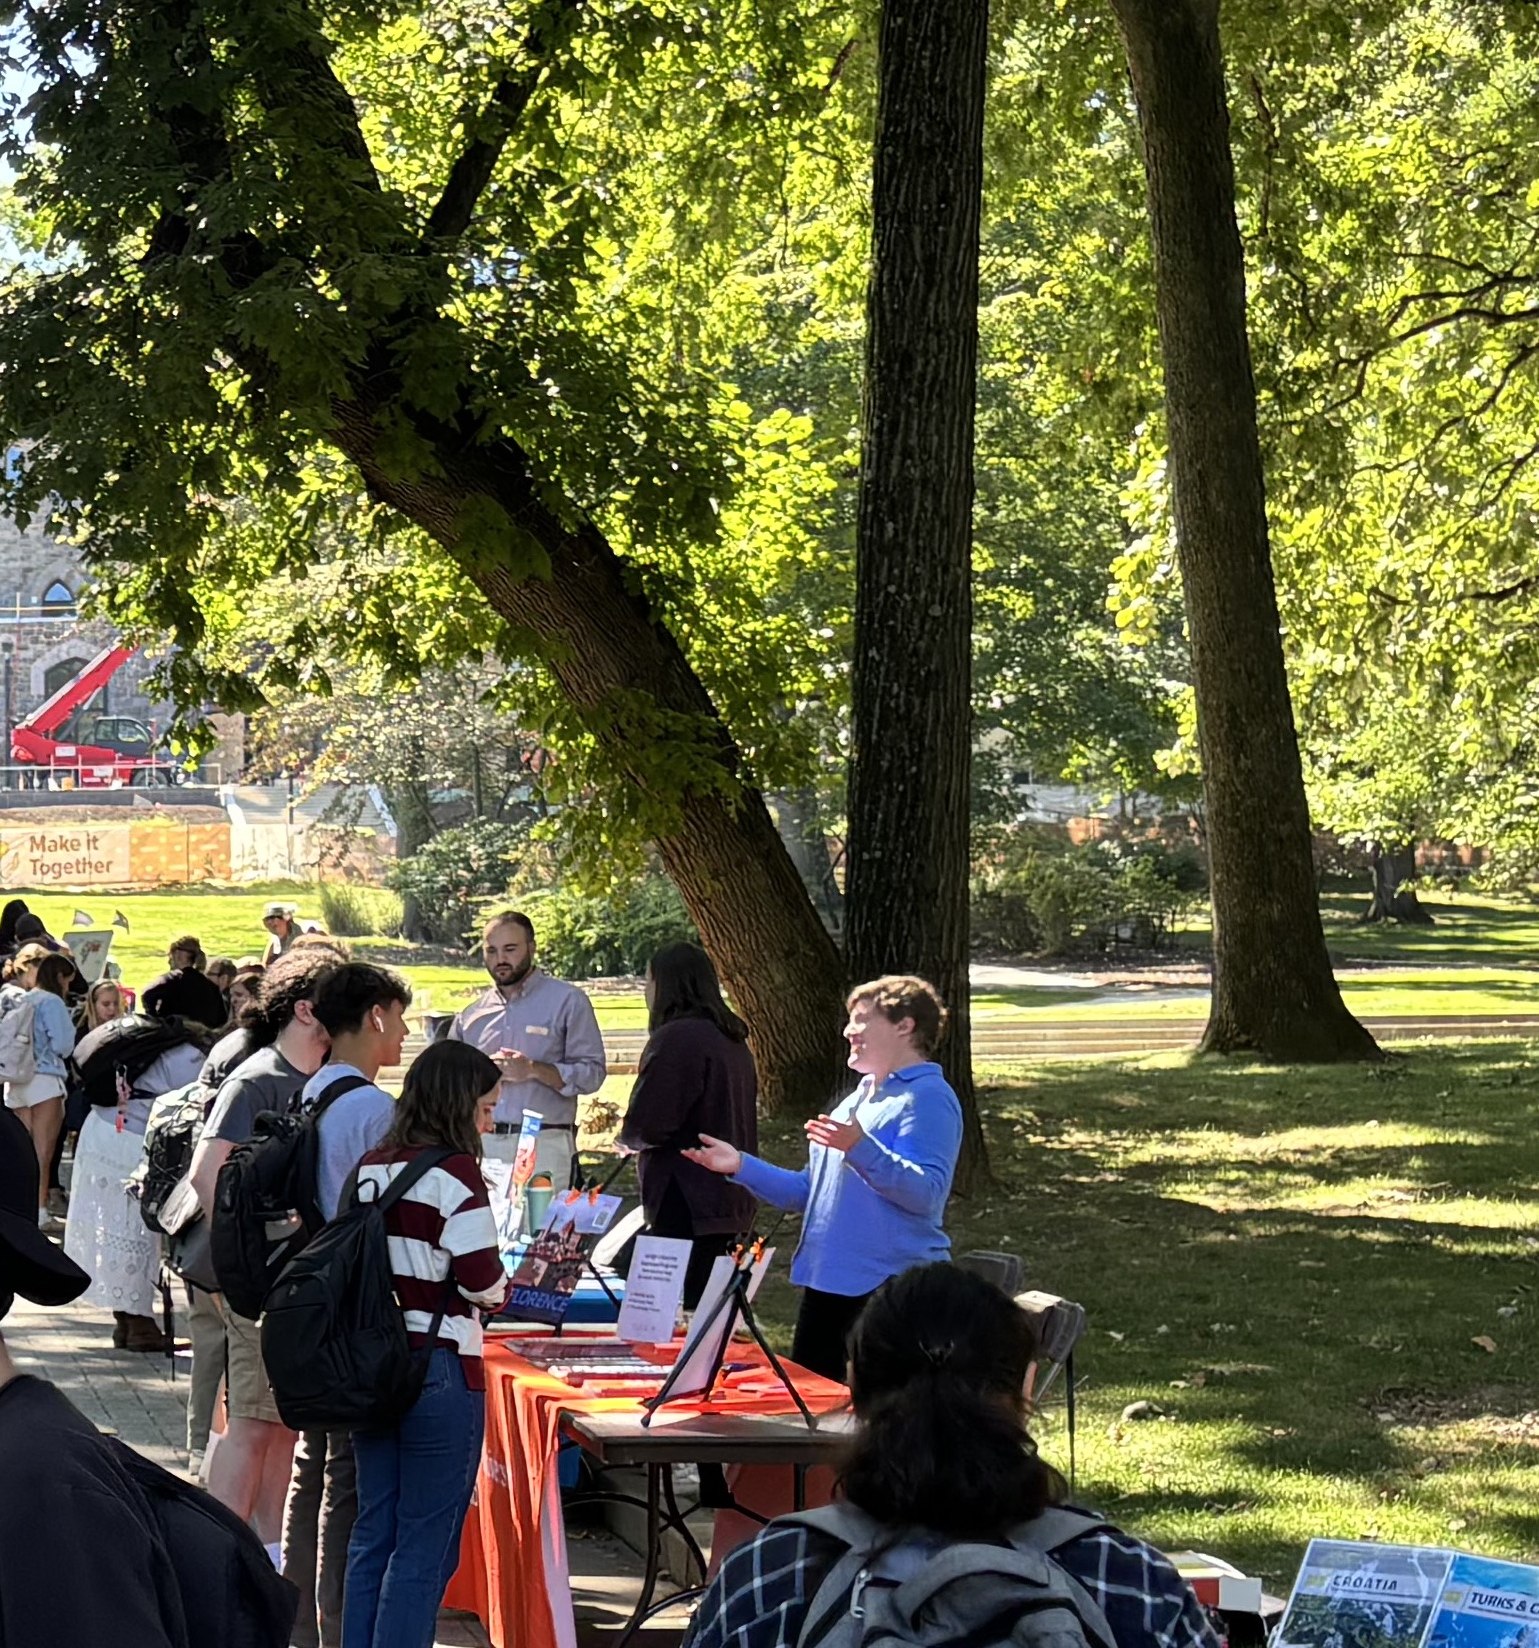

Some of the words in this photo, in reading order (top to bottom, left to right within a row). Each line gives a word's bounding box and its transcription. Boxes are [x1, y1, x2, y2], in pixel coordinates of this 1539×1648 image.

[29, 834, 82, 854] Make
[86, 833, 99, 852] it
[29, 857, 114, 877] Together
[511, 1287, 569, 1313] LORENCE
[1332, 1575, 1398, 1591] CROATIA
[1470, 1591, 1514, 1610] TURKS
[1515, 1600, 1527, 1611] &
